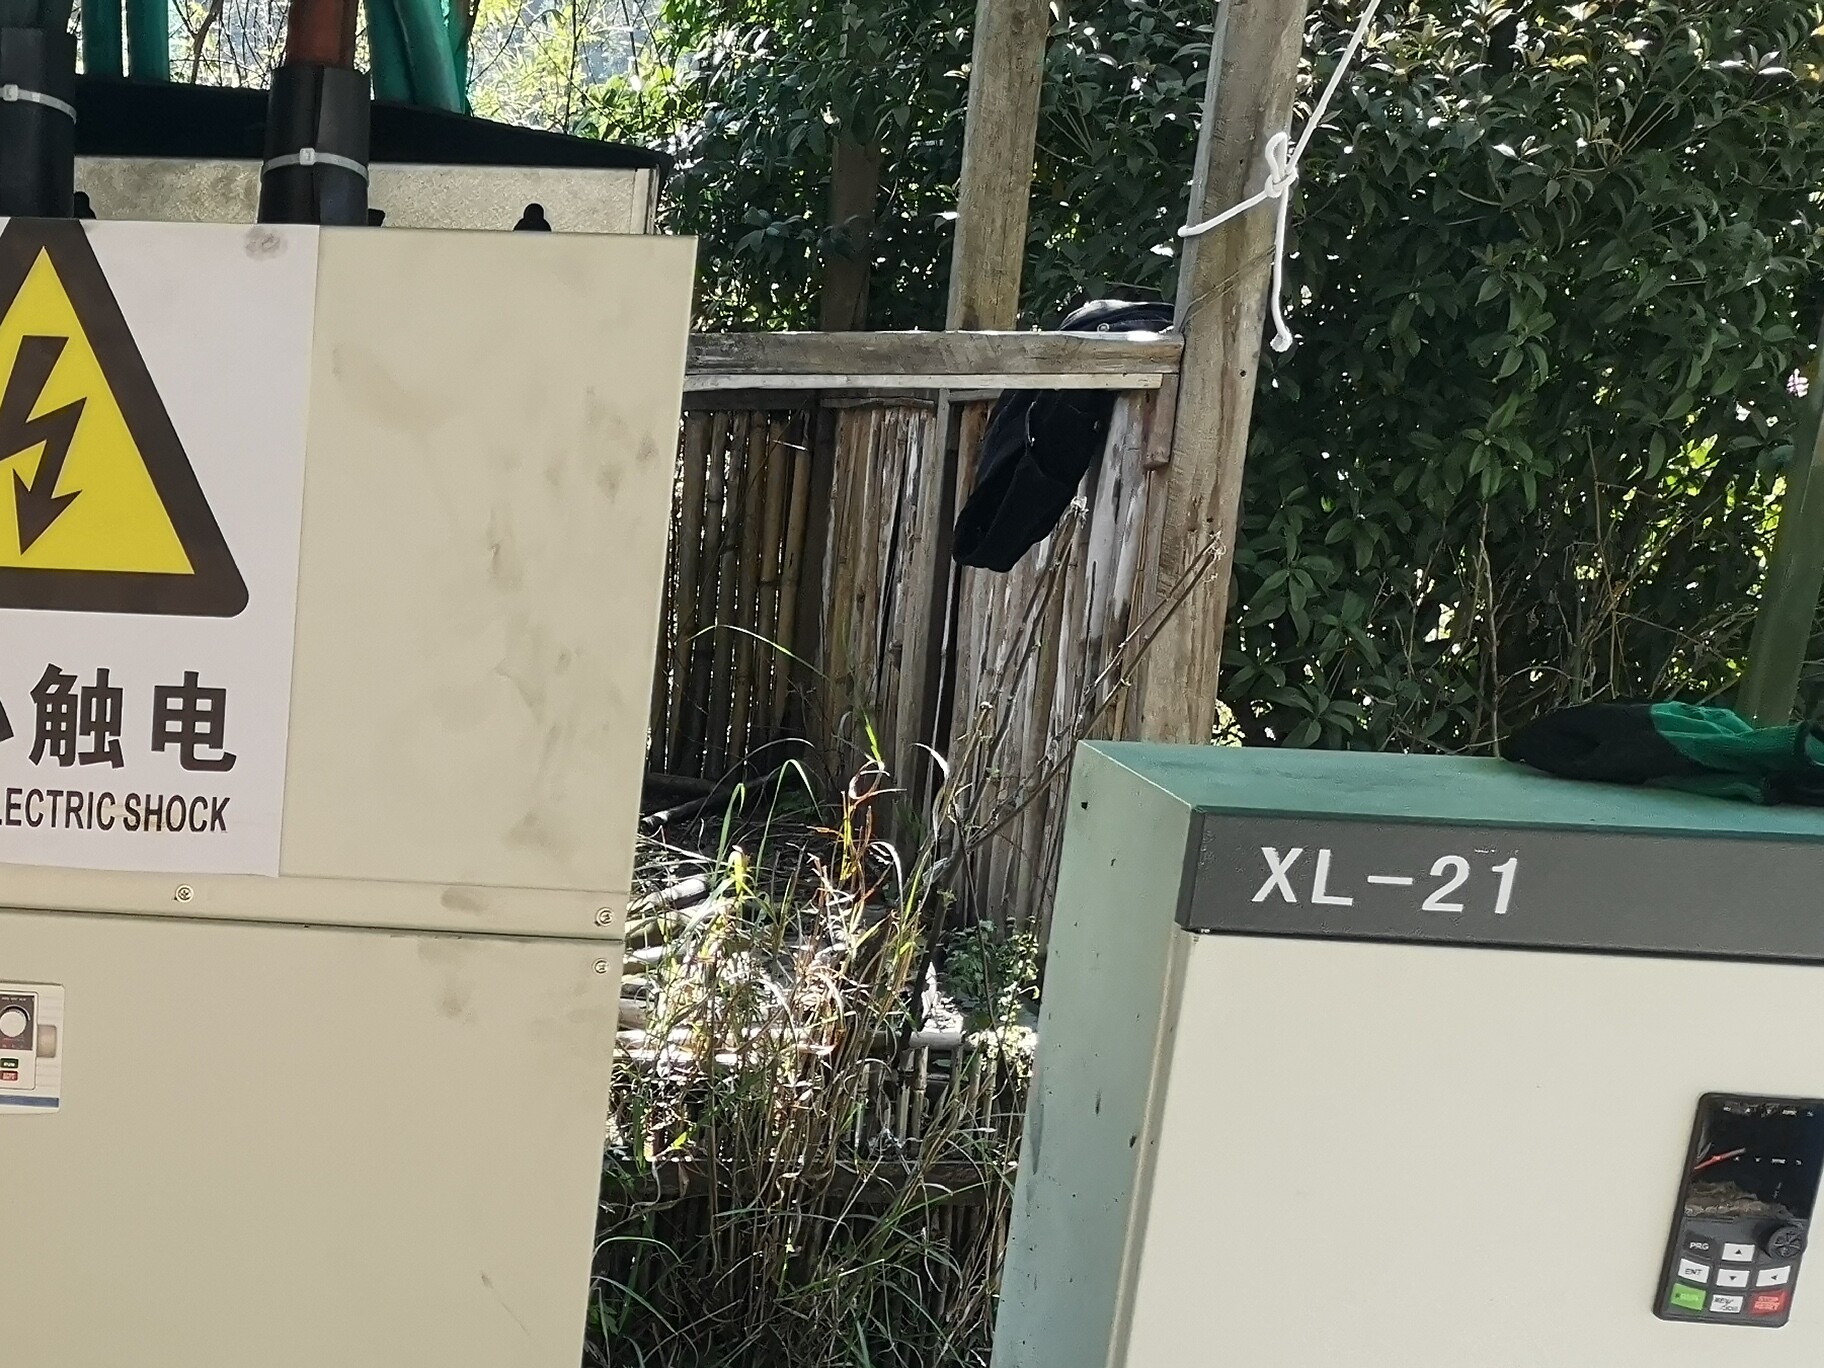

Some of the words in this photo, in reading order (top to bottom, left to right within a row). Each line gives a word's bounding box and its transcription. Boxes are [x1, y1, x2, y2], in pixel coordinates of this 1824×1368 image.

[122, 792, 231, 833] SHOCK
[1251, 846, 1519, 915] XL-21
[1689, 1241, 1709, 1251] PRG
[1684, 1268, 1703, 1276] ENT
